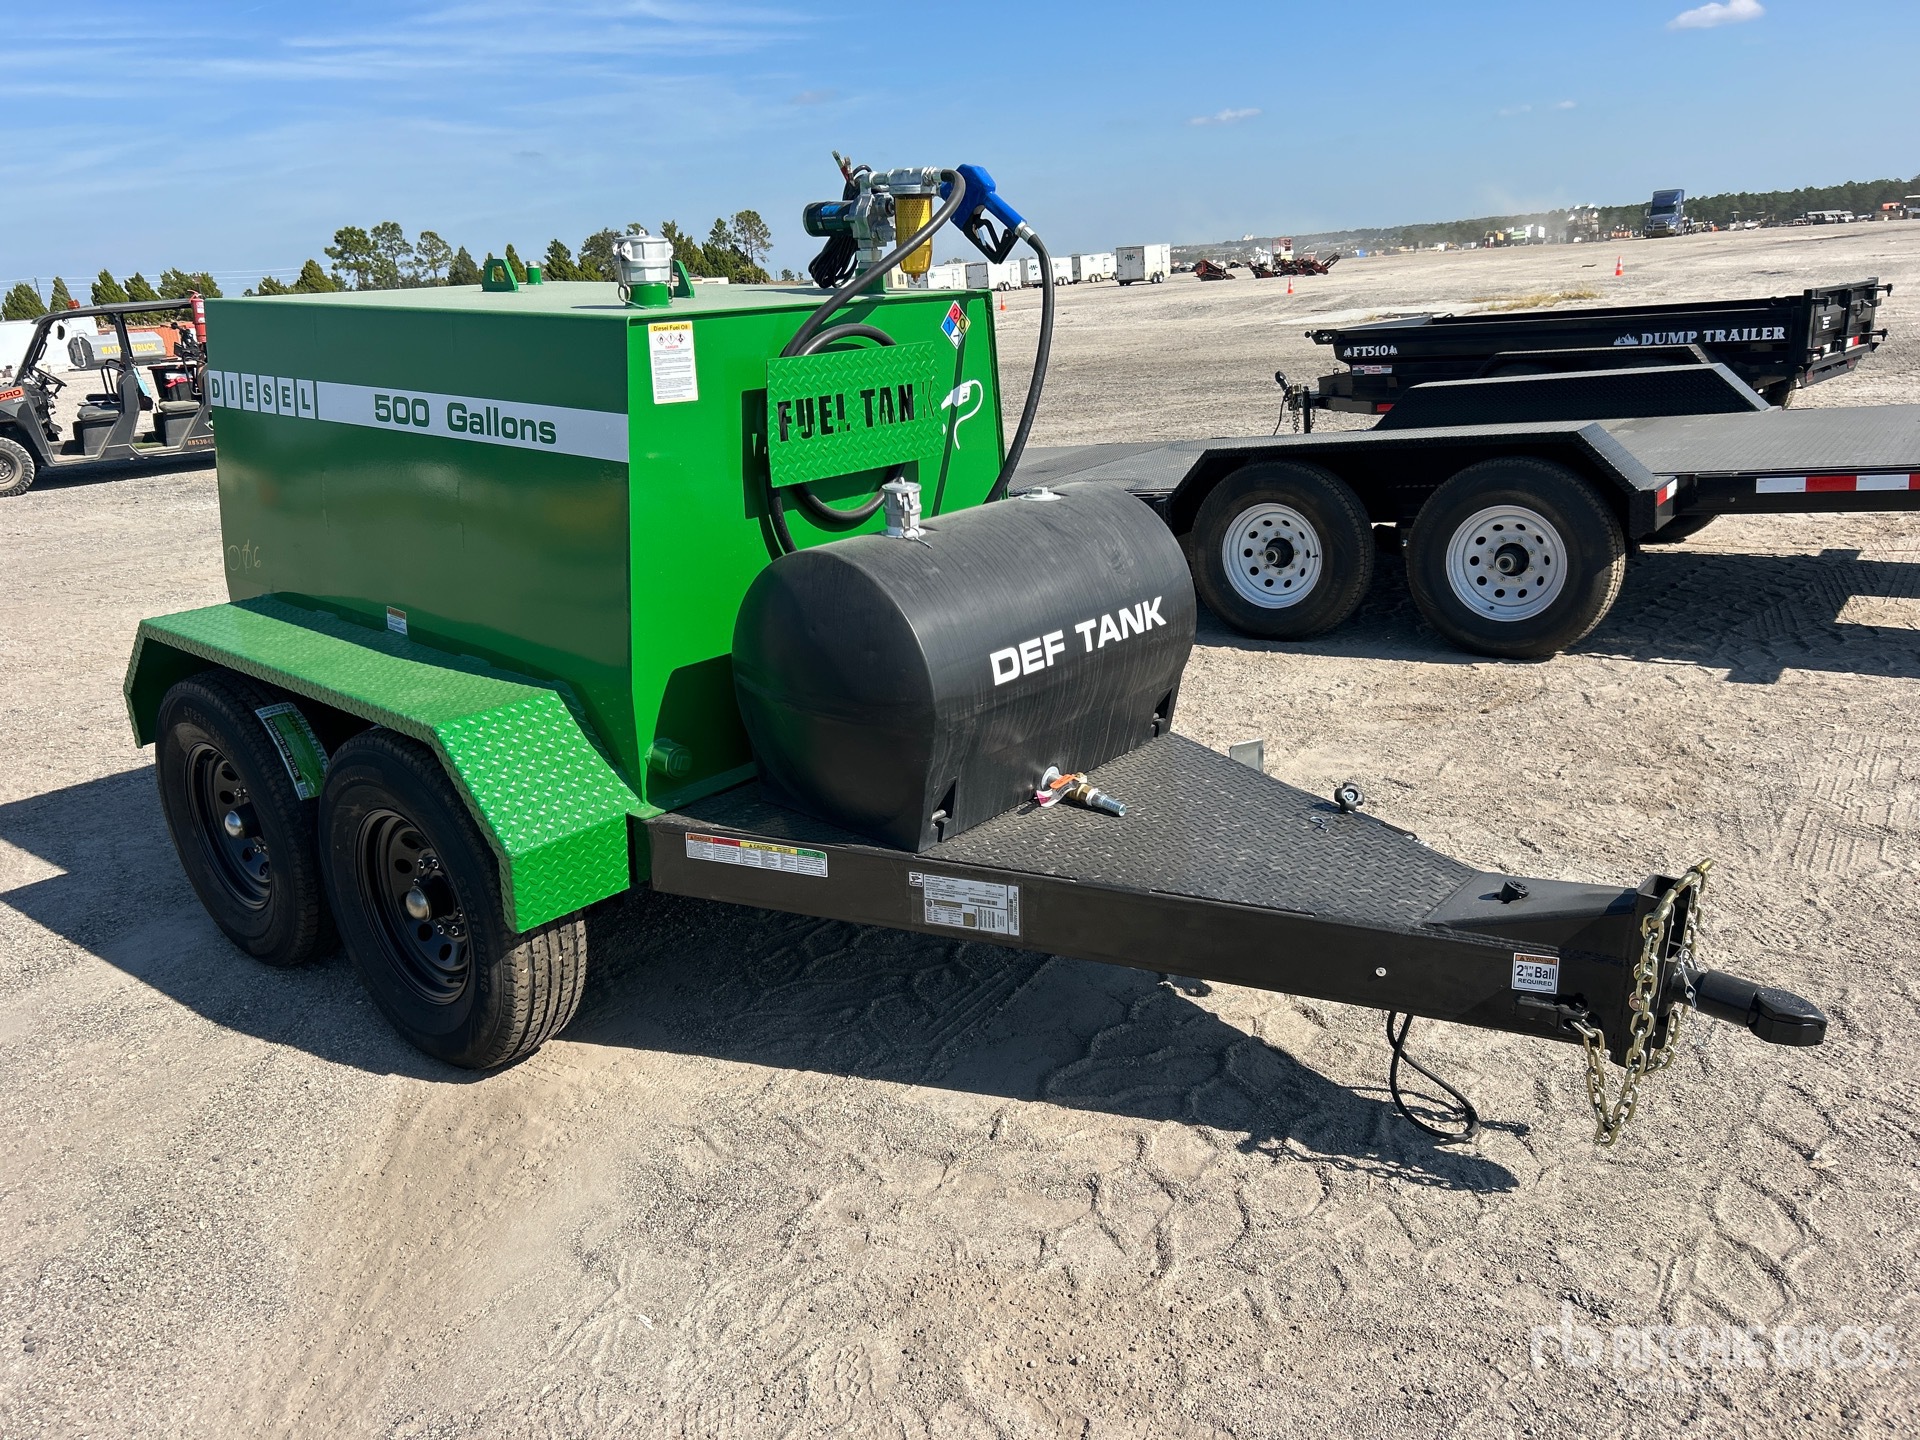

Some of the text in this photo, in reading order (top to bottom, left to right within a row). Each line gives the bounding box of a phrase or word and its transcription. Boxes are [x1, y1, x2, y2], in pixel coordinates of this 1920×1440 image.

[953, 308, 958, 320] 2
[960, 318, 966, 330] 0
[1640, 326, 1786, 346] DUMP TRAILER
[133, 342, 158, 353] TRUCK
[1352, 344, 1389, 358] FT510
[0, 389, 21, 401] PRO
[212, 378, 311, 410] DIESEL
[777, 380, 934, 442] FUEL TANK
[374, 394, 557, 445] 500 Gallons
[989, 595, 1167, 686] DEF TANK
[1534, 966, 1555, 980] Ball
[1517, 978, 1553, 987] REQUIRED
